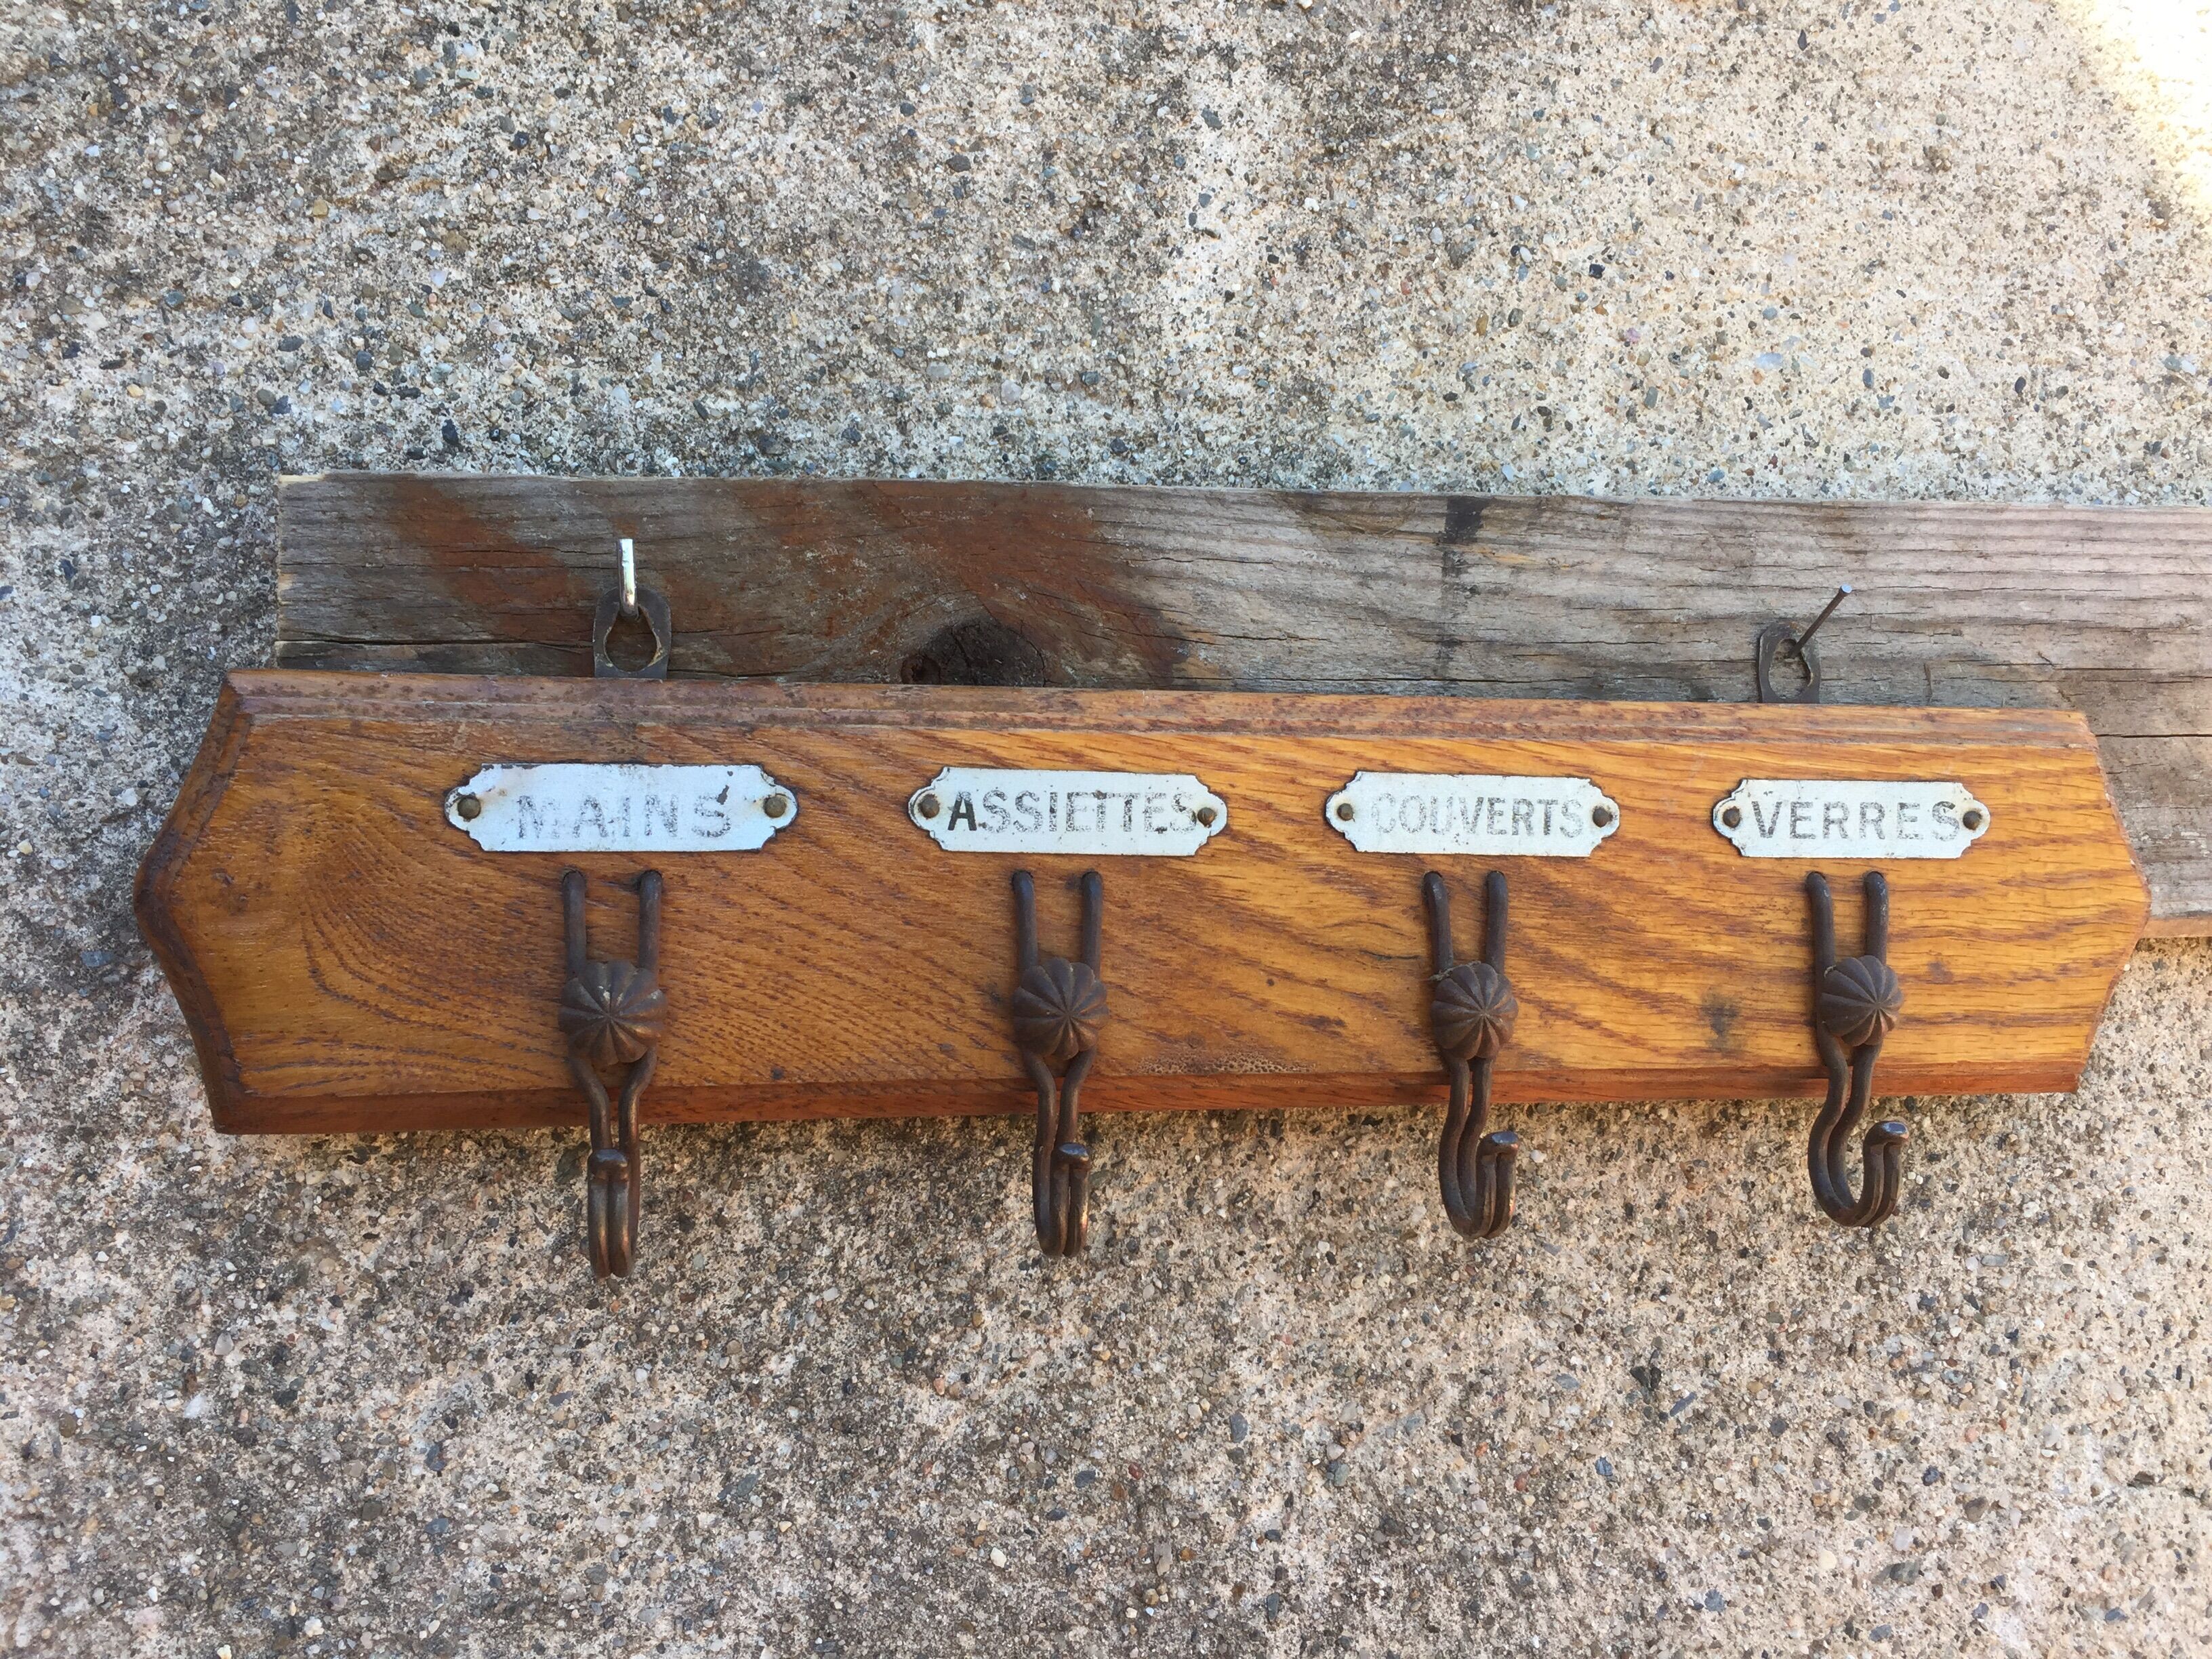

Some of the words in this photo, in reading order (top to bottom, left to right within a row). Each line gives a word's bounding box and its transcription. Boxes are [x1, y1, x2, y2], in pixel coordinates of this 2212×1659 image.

[947, 790, 1197, 834] ASSIETTES
[1371, 792, 1584, 838] COUVERTS
[1750, 800, 1960, 840] VERRES
